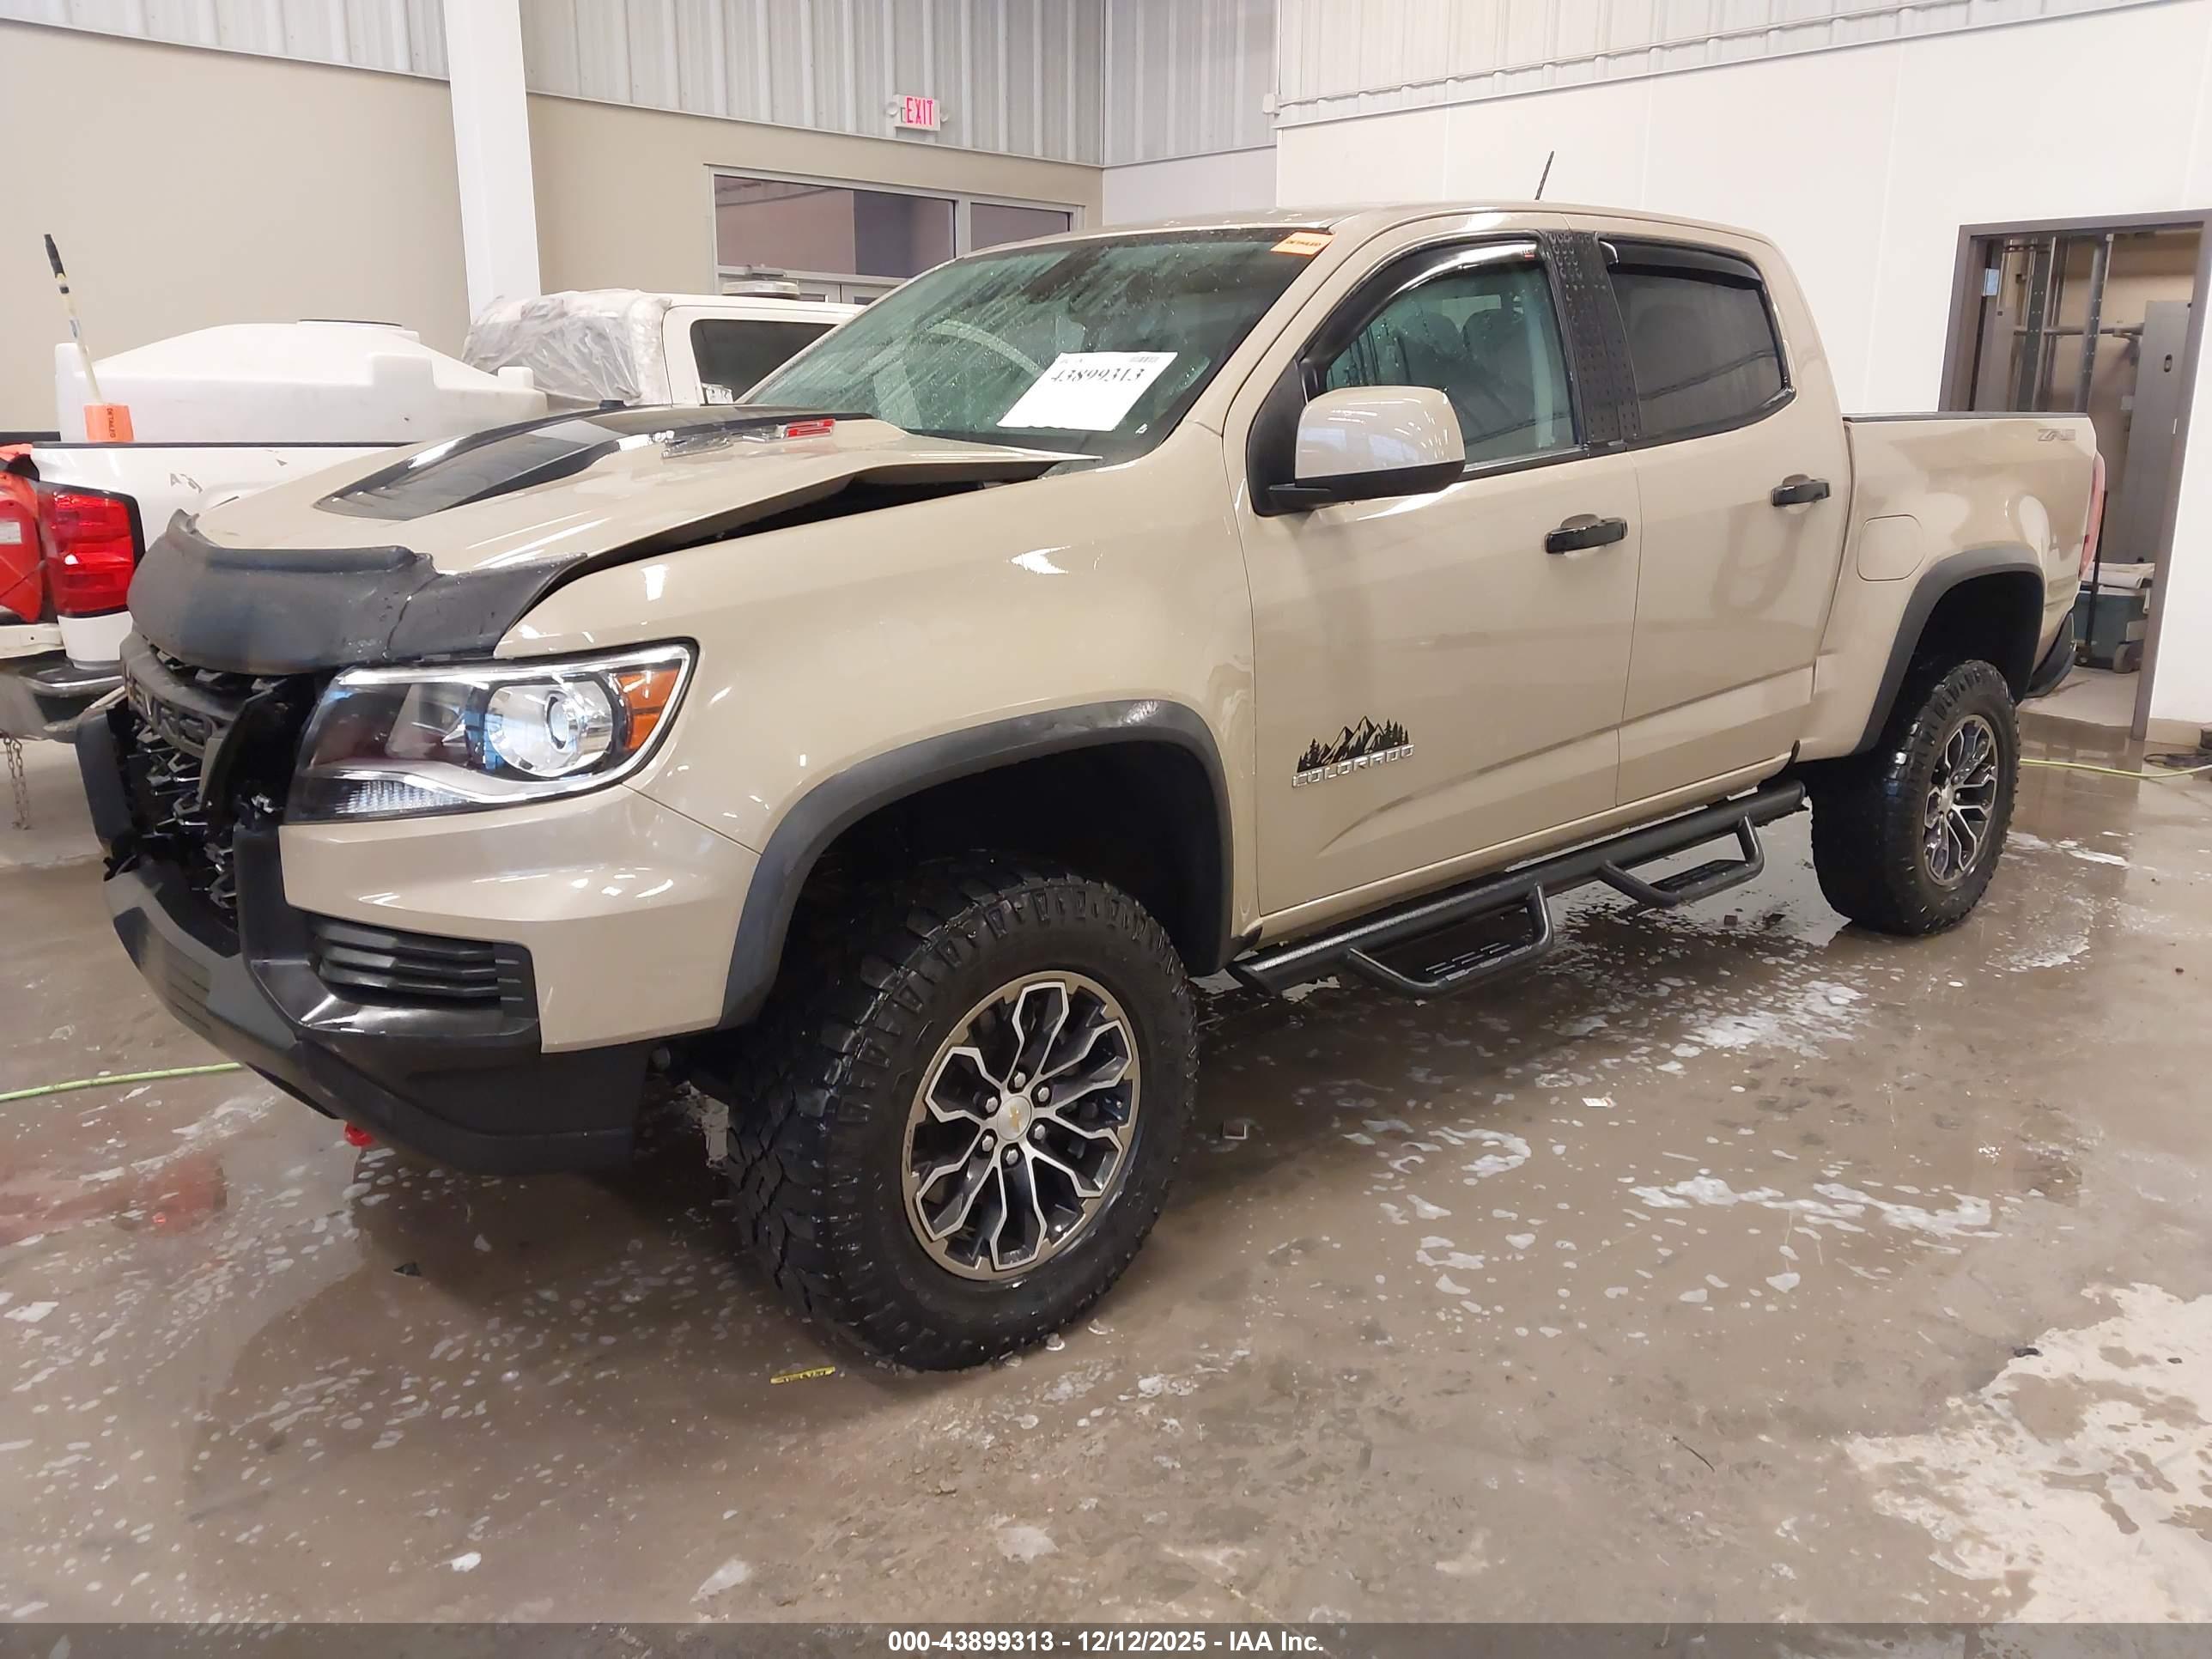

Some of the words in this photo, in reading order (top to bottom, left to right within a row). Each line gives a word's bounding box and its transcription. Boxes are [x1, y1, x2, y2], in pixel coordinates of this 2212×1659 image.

[906, 97, 933, 125] EXIT
[1051, 368, 1146, 382] 43899313
[1291, 744, 1415, 787] COLORADO
